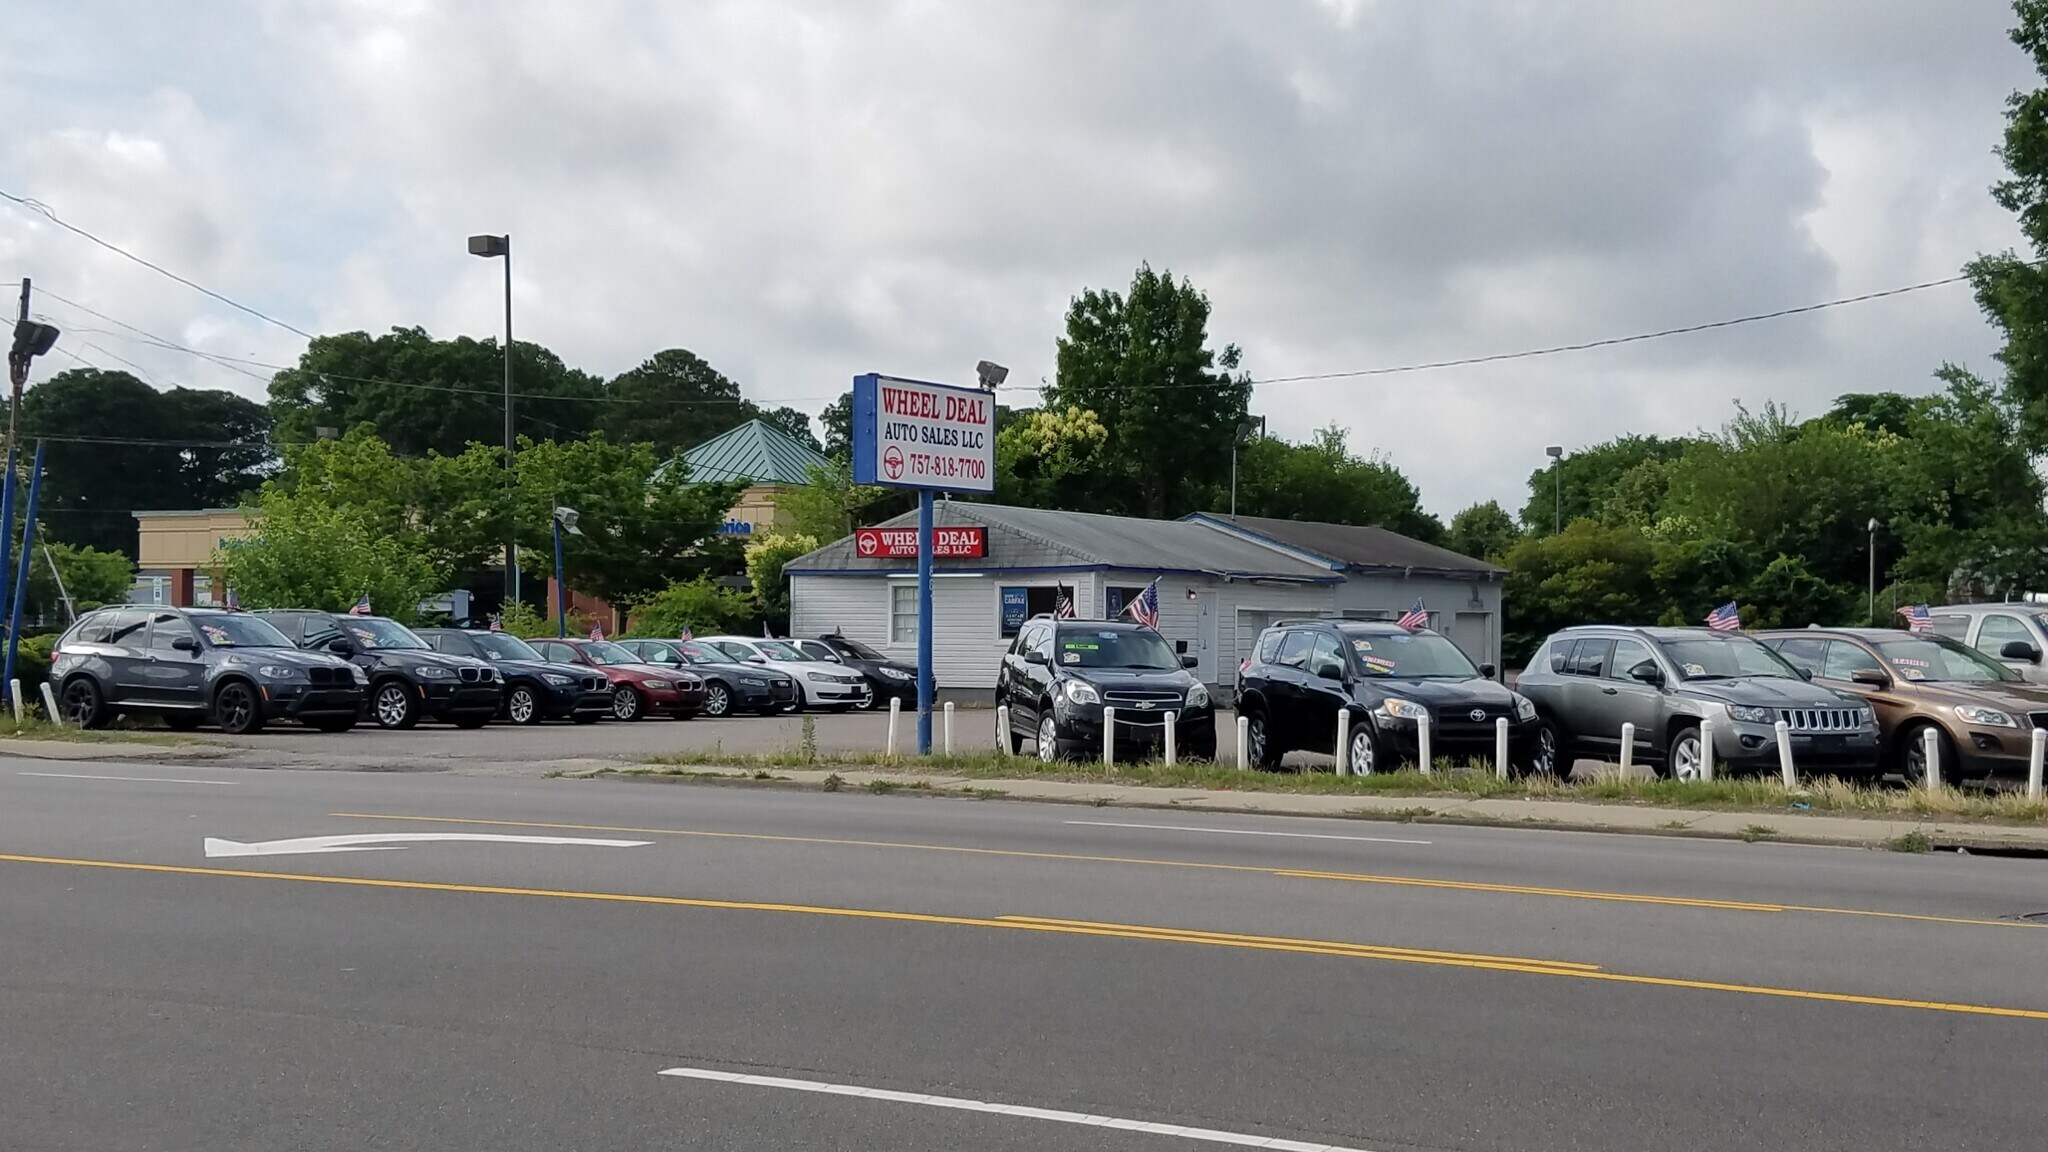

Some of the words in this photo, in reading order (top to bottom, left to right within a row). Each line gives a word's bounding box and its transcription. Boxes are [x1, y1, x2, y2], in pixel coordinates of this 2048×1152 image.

[882, 387, 940, 419] WHEEL
[945, 396, 987, 425] DEAL
[885, 422, 918, 442] AUTO
[921, 426, 958, 446] SALES
[962, 431, 984, 449] LLC
[910, 453, 985, 479] 757-818-7700
[880, 532, 934, 546] WHE
[938, 531, 979, 546] DEAL
[889, 546, 916, 554] AUTO
[932, 546, 950, 554] LES
[952, 545, 972, 554] LLC
